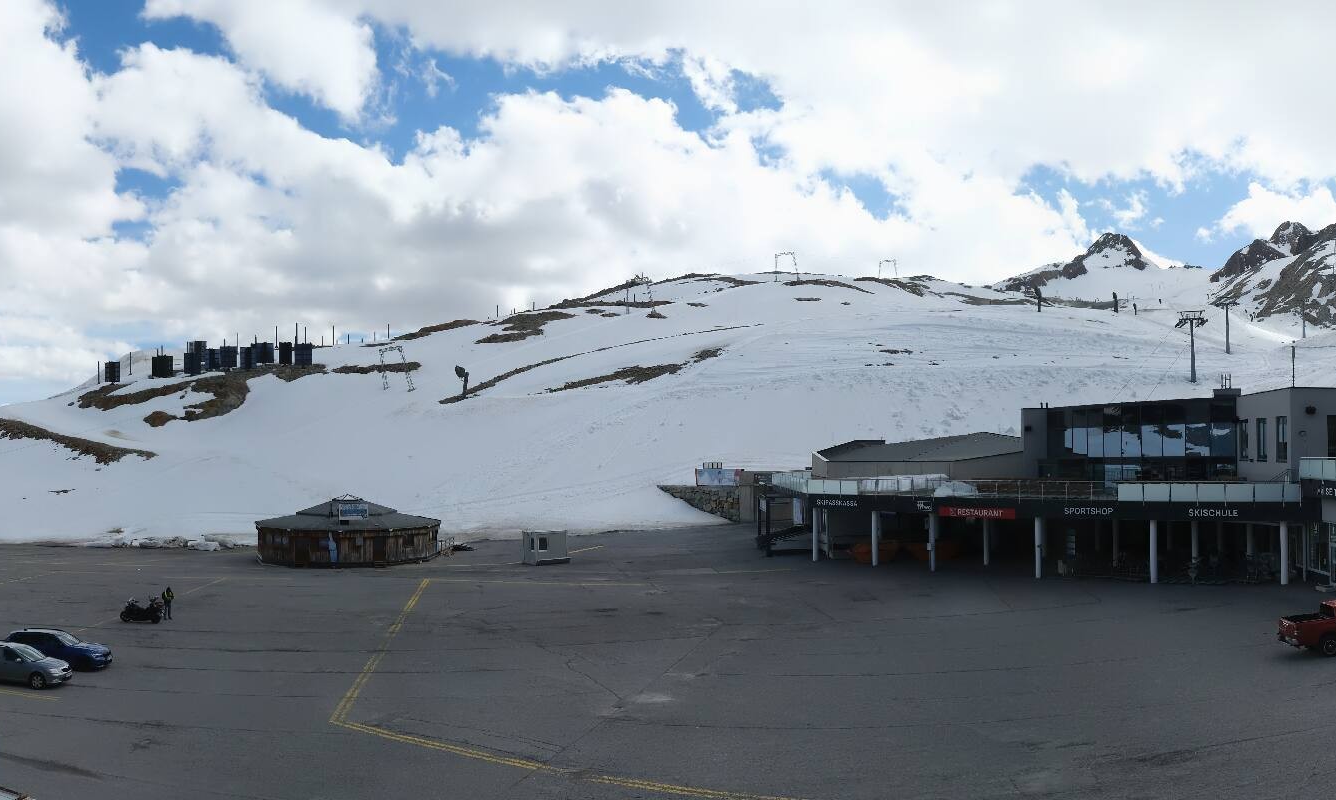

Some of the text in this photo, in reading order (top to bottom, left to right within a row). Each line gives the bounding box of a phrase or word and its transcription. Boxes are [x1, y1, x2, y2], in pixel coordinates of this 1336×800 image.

[957, 508, 1004, 517] RESTAURANT
[1064, 507, 1114, 515] SPORTSHOP
[1188, 508, 1239, 517] SKISCHULE
